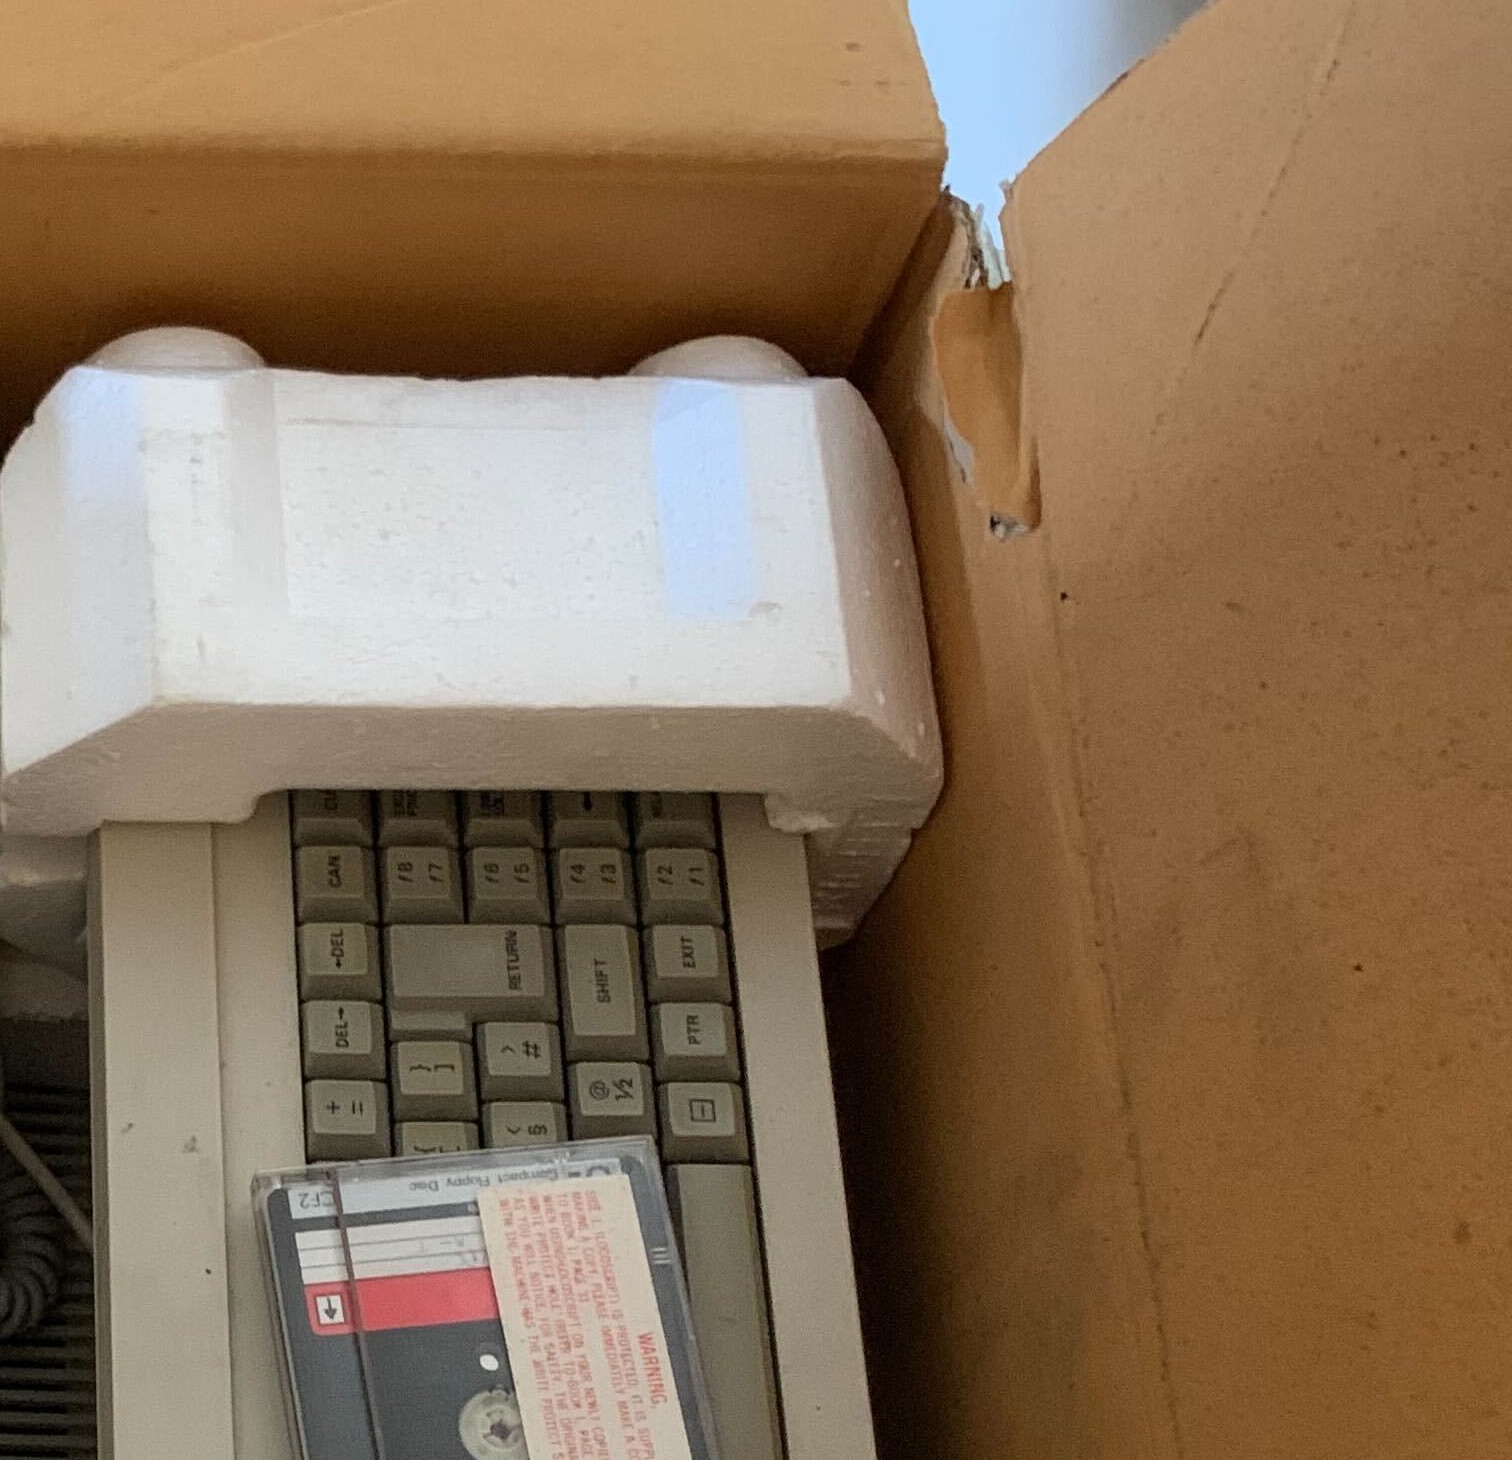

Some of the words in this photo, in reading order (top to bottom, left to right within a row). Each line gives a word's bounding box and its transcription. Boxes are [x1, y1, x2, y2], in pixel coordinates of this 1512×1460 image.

[328, 855, 343, 889] CAN
[507, 930, 524, 991] RETURN
[682, 935, 697, 968] EXIT
[595, 958, 612, 1004] SHIFT
[686, 1014, 701, 1045] PTR
[408, 1179, 439, 1192] Disc
[446, 1174, 490, 1188] Floppy
[516, 1216, 531, 1238] YOU
[589, 1282, 609, 1320] PLEASE
[599, 1325, 625, 1394] IMMEDIATELY
[616, 1399, 633, 1430] MAKE
[540, 1398, 561, 1446] PROTECT
